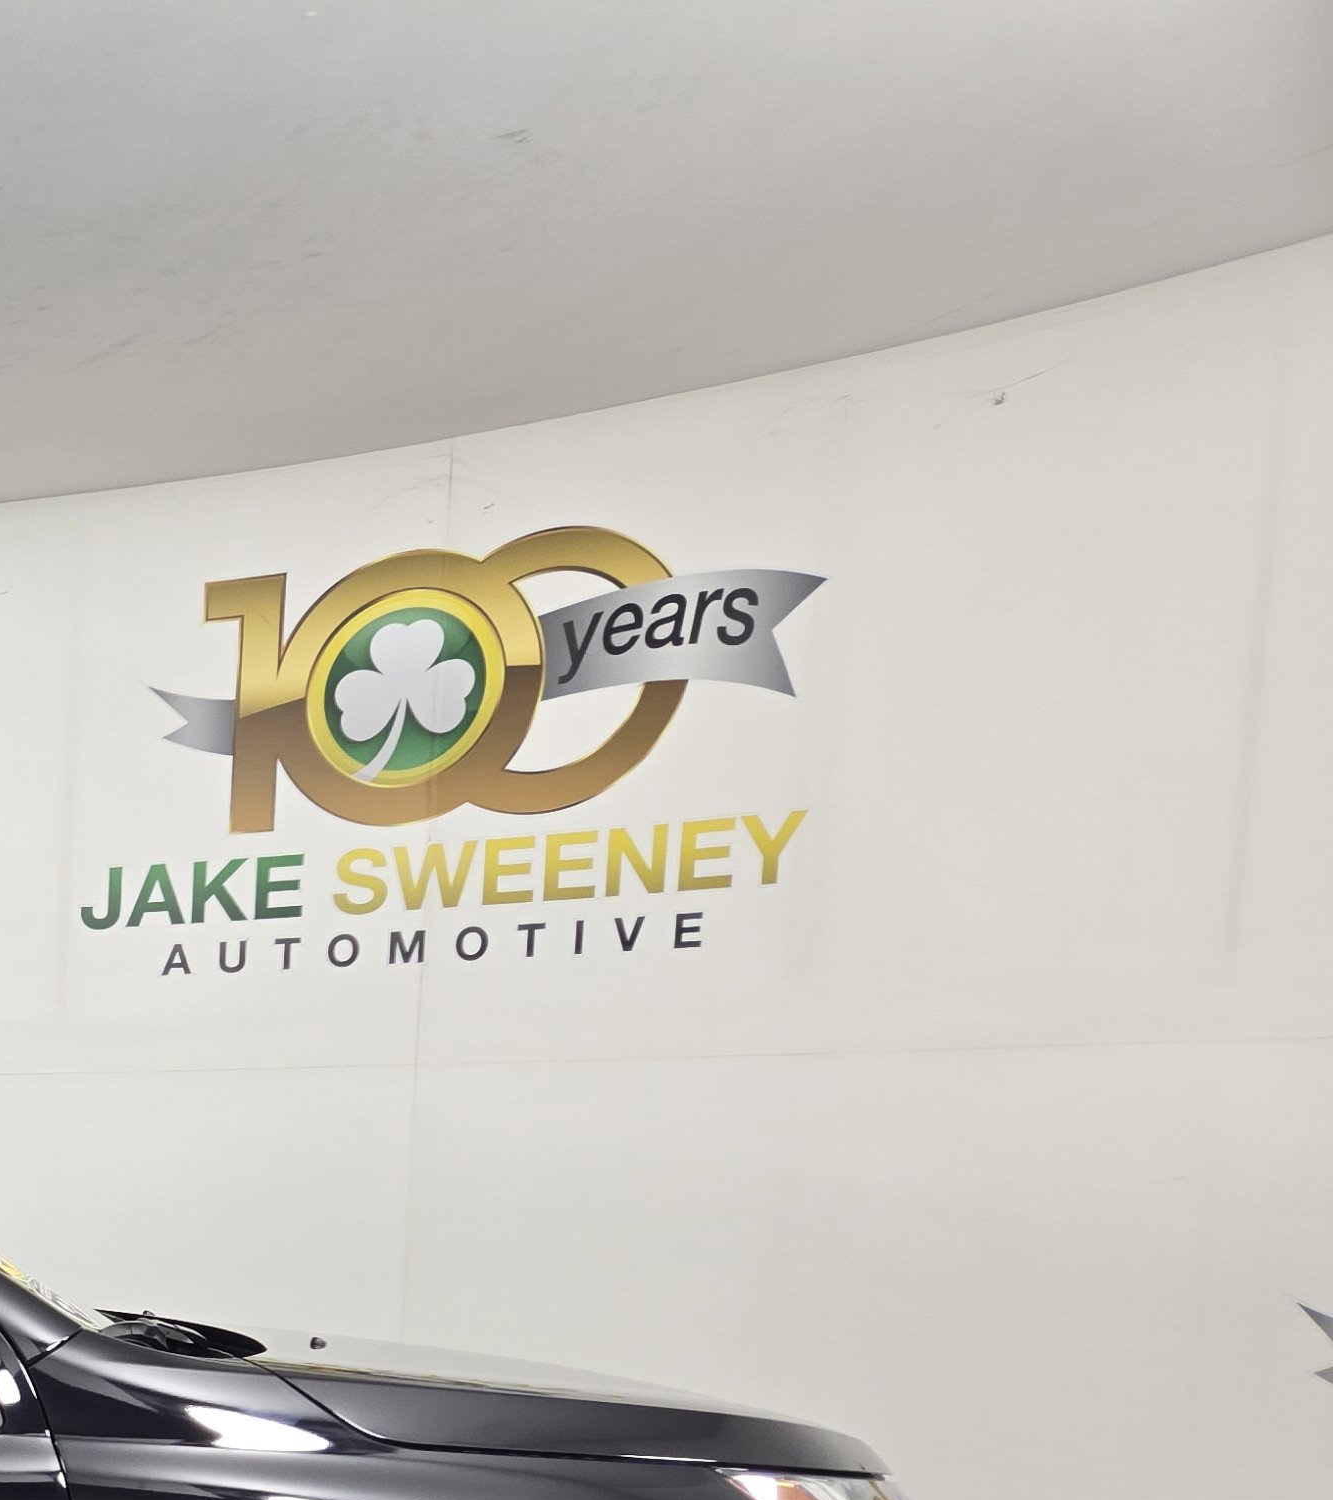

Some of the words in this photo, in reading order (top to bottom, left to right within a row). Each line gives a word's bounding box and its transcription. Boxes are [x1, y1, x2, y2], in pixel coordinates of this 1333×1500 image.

[204, 525, 689, 835] 100
[557, 586, 760, 686] years
[80, 853, 306, 931] JAKE
[333, 809, 809, 916] SWEENEY
[161, 911, 705, 978] AUTOMOTIVE
